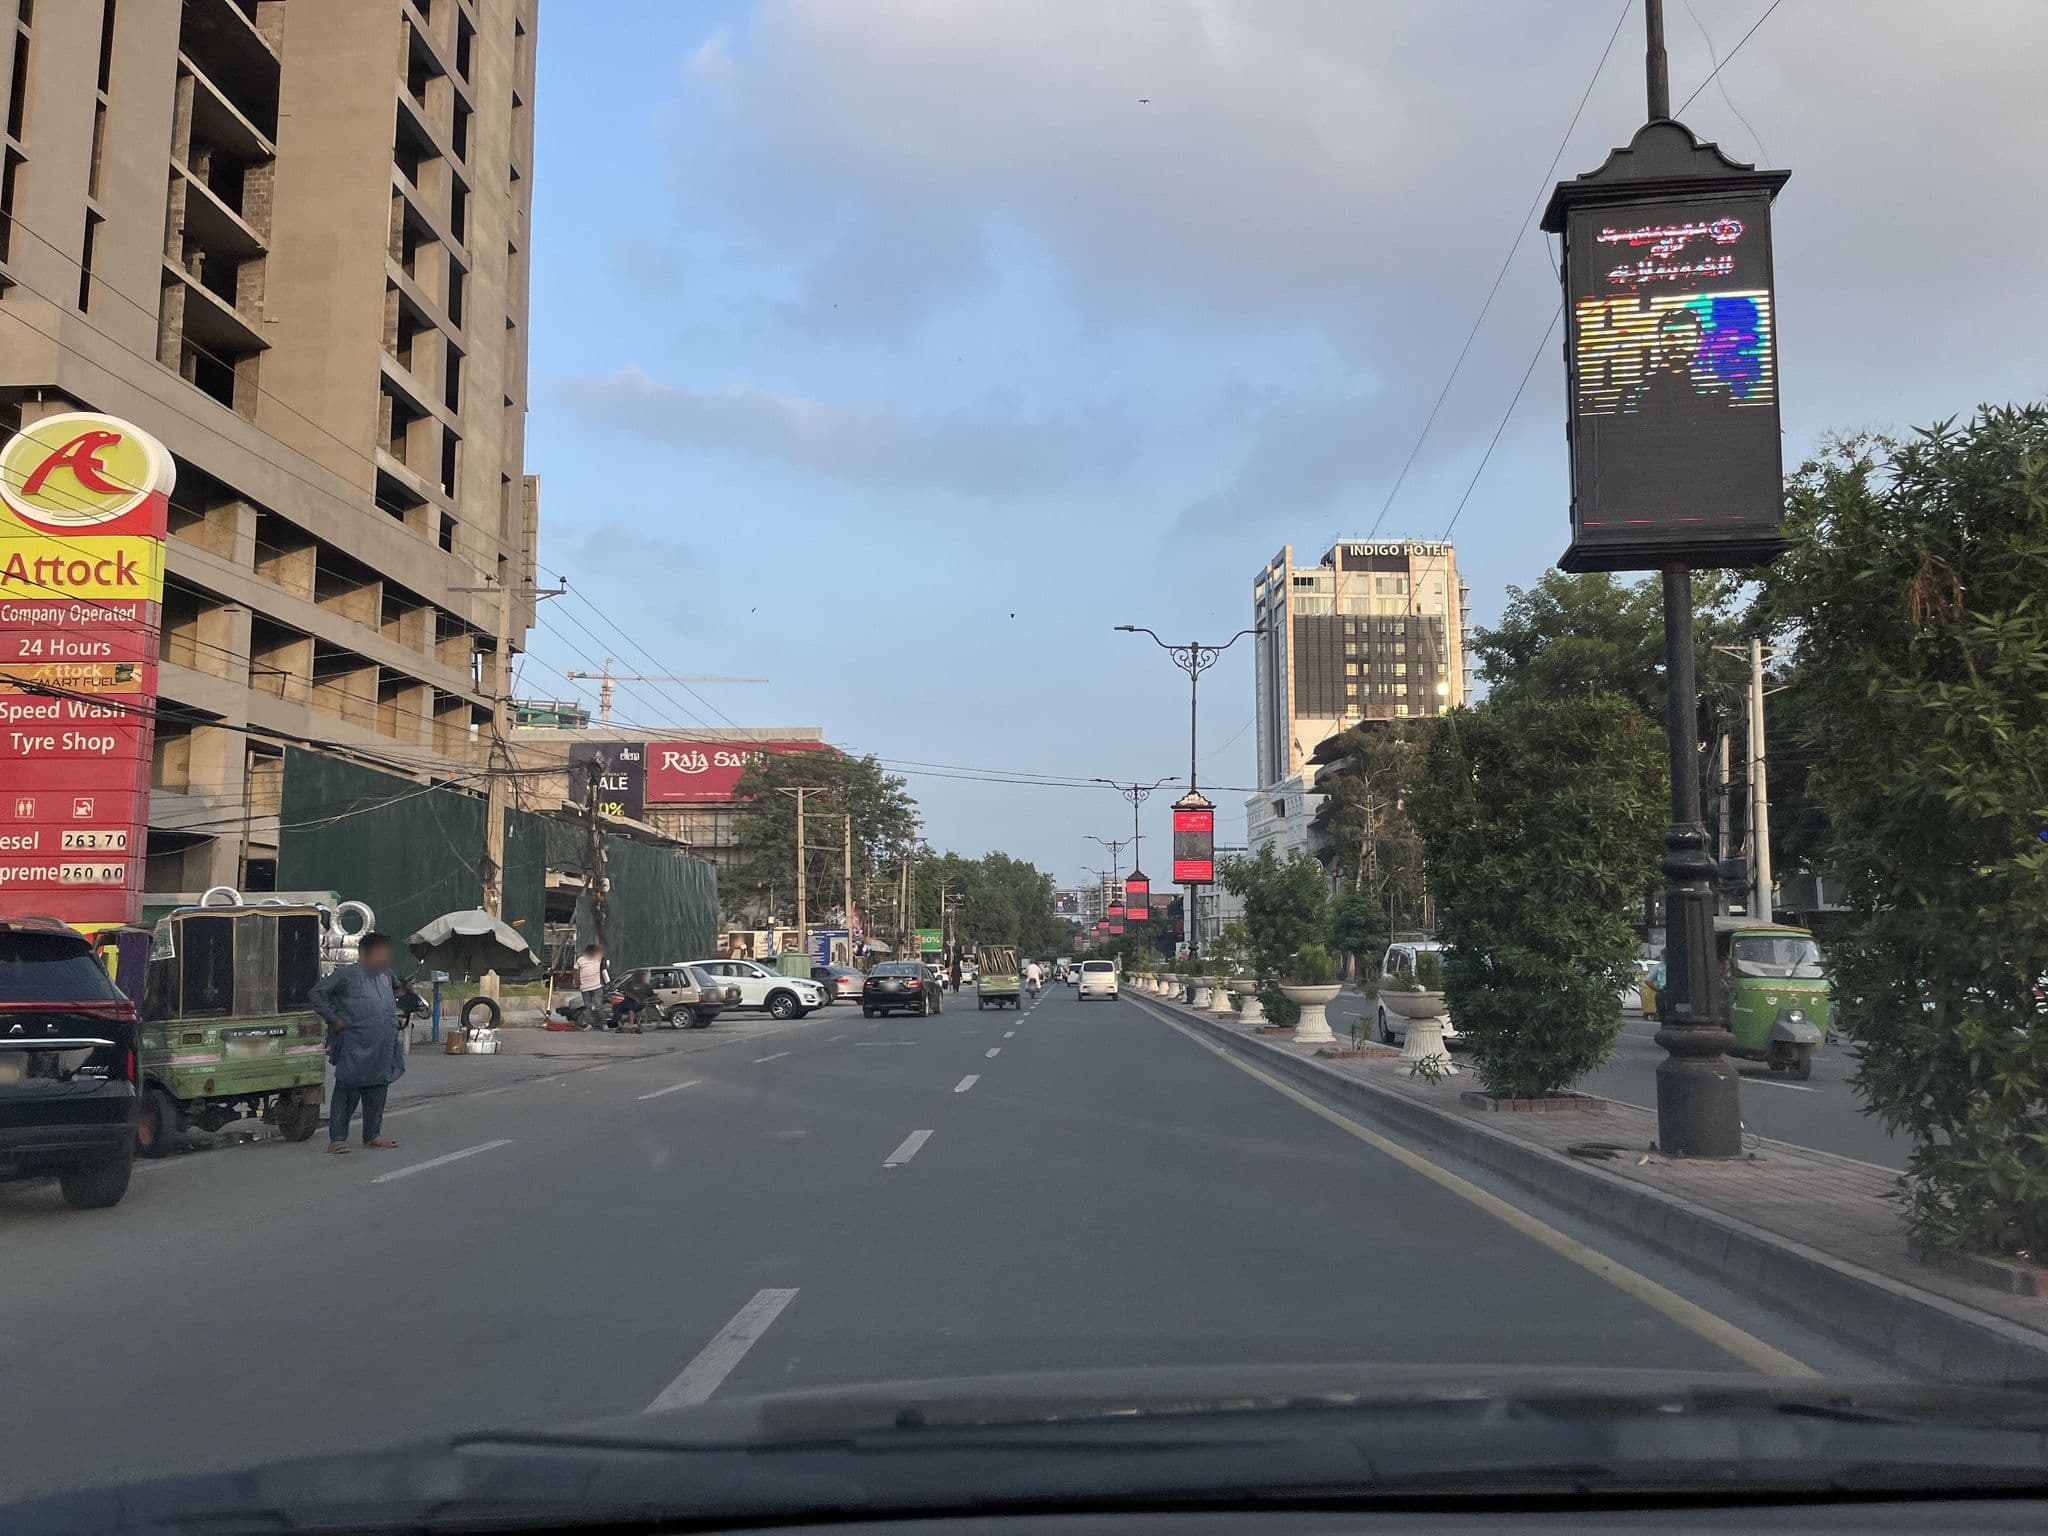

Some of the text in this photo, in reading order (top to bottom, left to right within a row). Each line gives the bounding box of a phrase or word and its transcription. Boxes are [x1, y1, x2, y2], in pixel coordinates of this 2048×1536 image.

[1350, 545, 1448, 556] INDIGO HOTEL
[1, 550, 139, 586] Attock
[2, 604, 136, 625] Company Operated
[18, 639, 111, 656] 24 Hours
[84, 677, 117, 687] FUEL
[0, 701, 126, 724] Speed Wash
[10, 732, 115, 756] Tyre Shop
[661, 750, 709, 774] Raja
